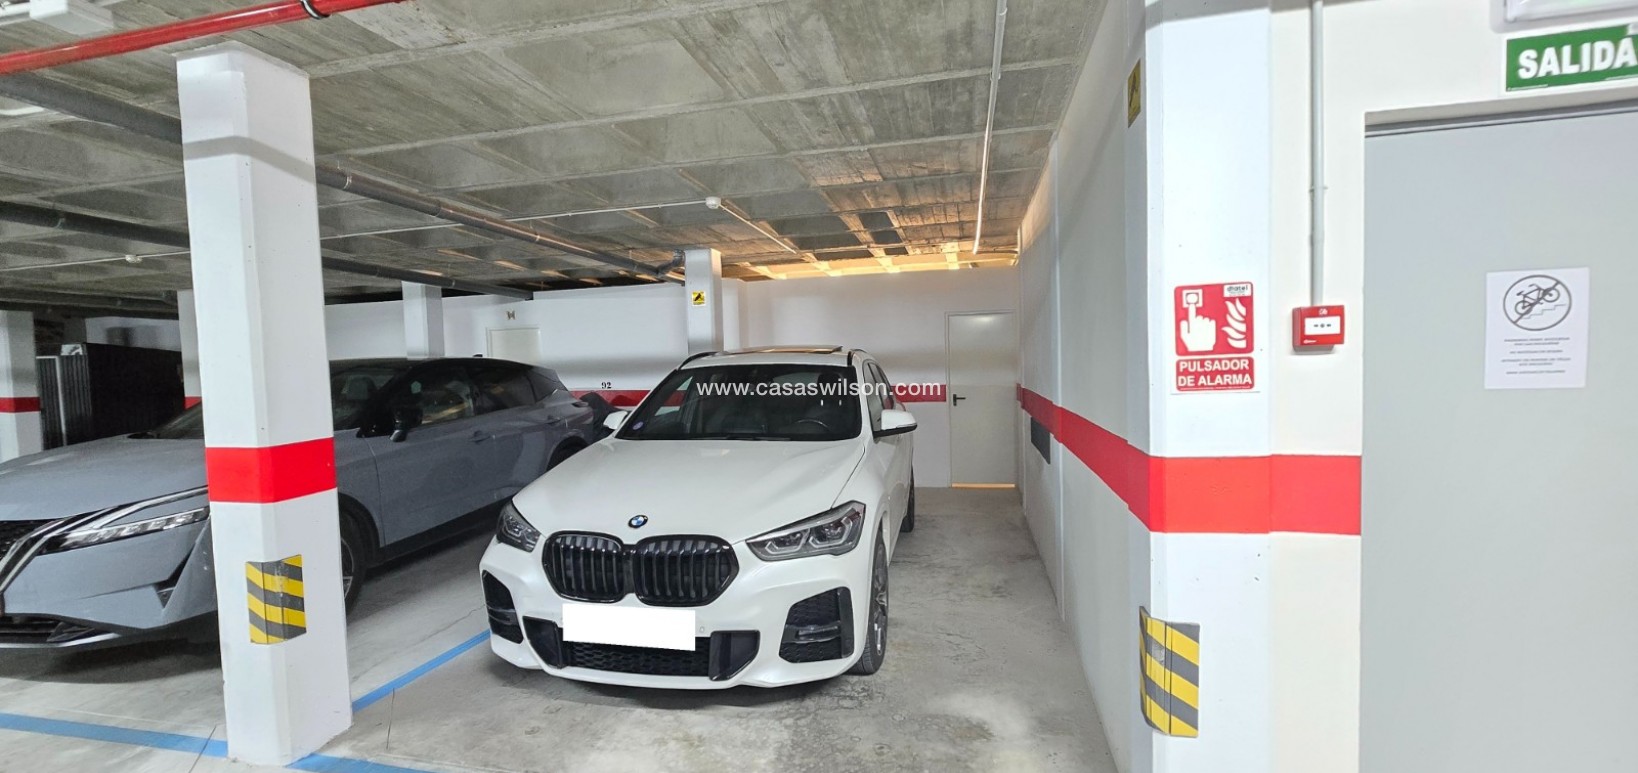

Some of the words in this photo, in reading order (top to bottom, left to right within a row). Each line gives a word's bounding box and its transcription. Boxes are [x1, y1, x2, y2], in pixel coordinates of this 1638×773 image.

[1518, 37, 1638, 79] SALIDA
[1179, 359, 1249, 372] PULSADOR
[601, 381, 612, 389] 92
[1178, 375, 1195, 386] DE
[1198, 373, 1252, 386] ALARMA
